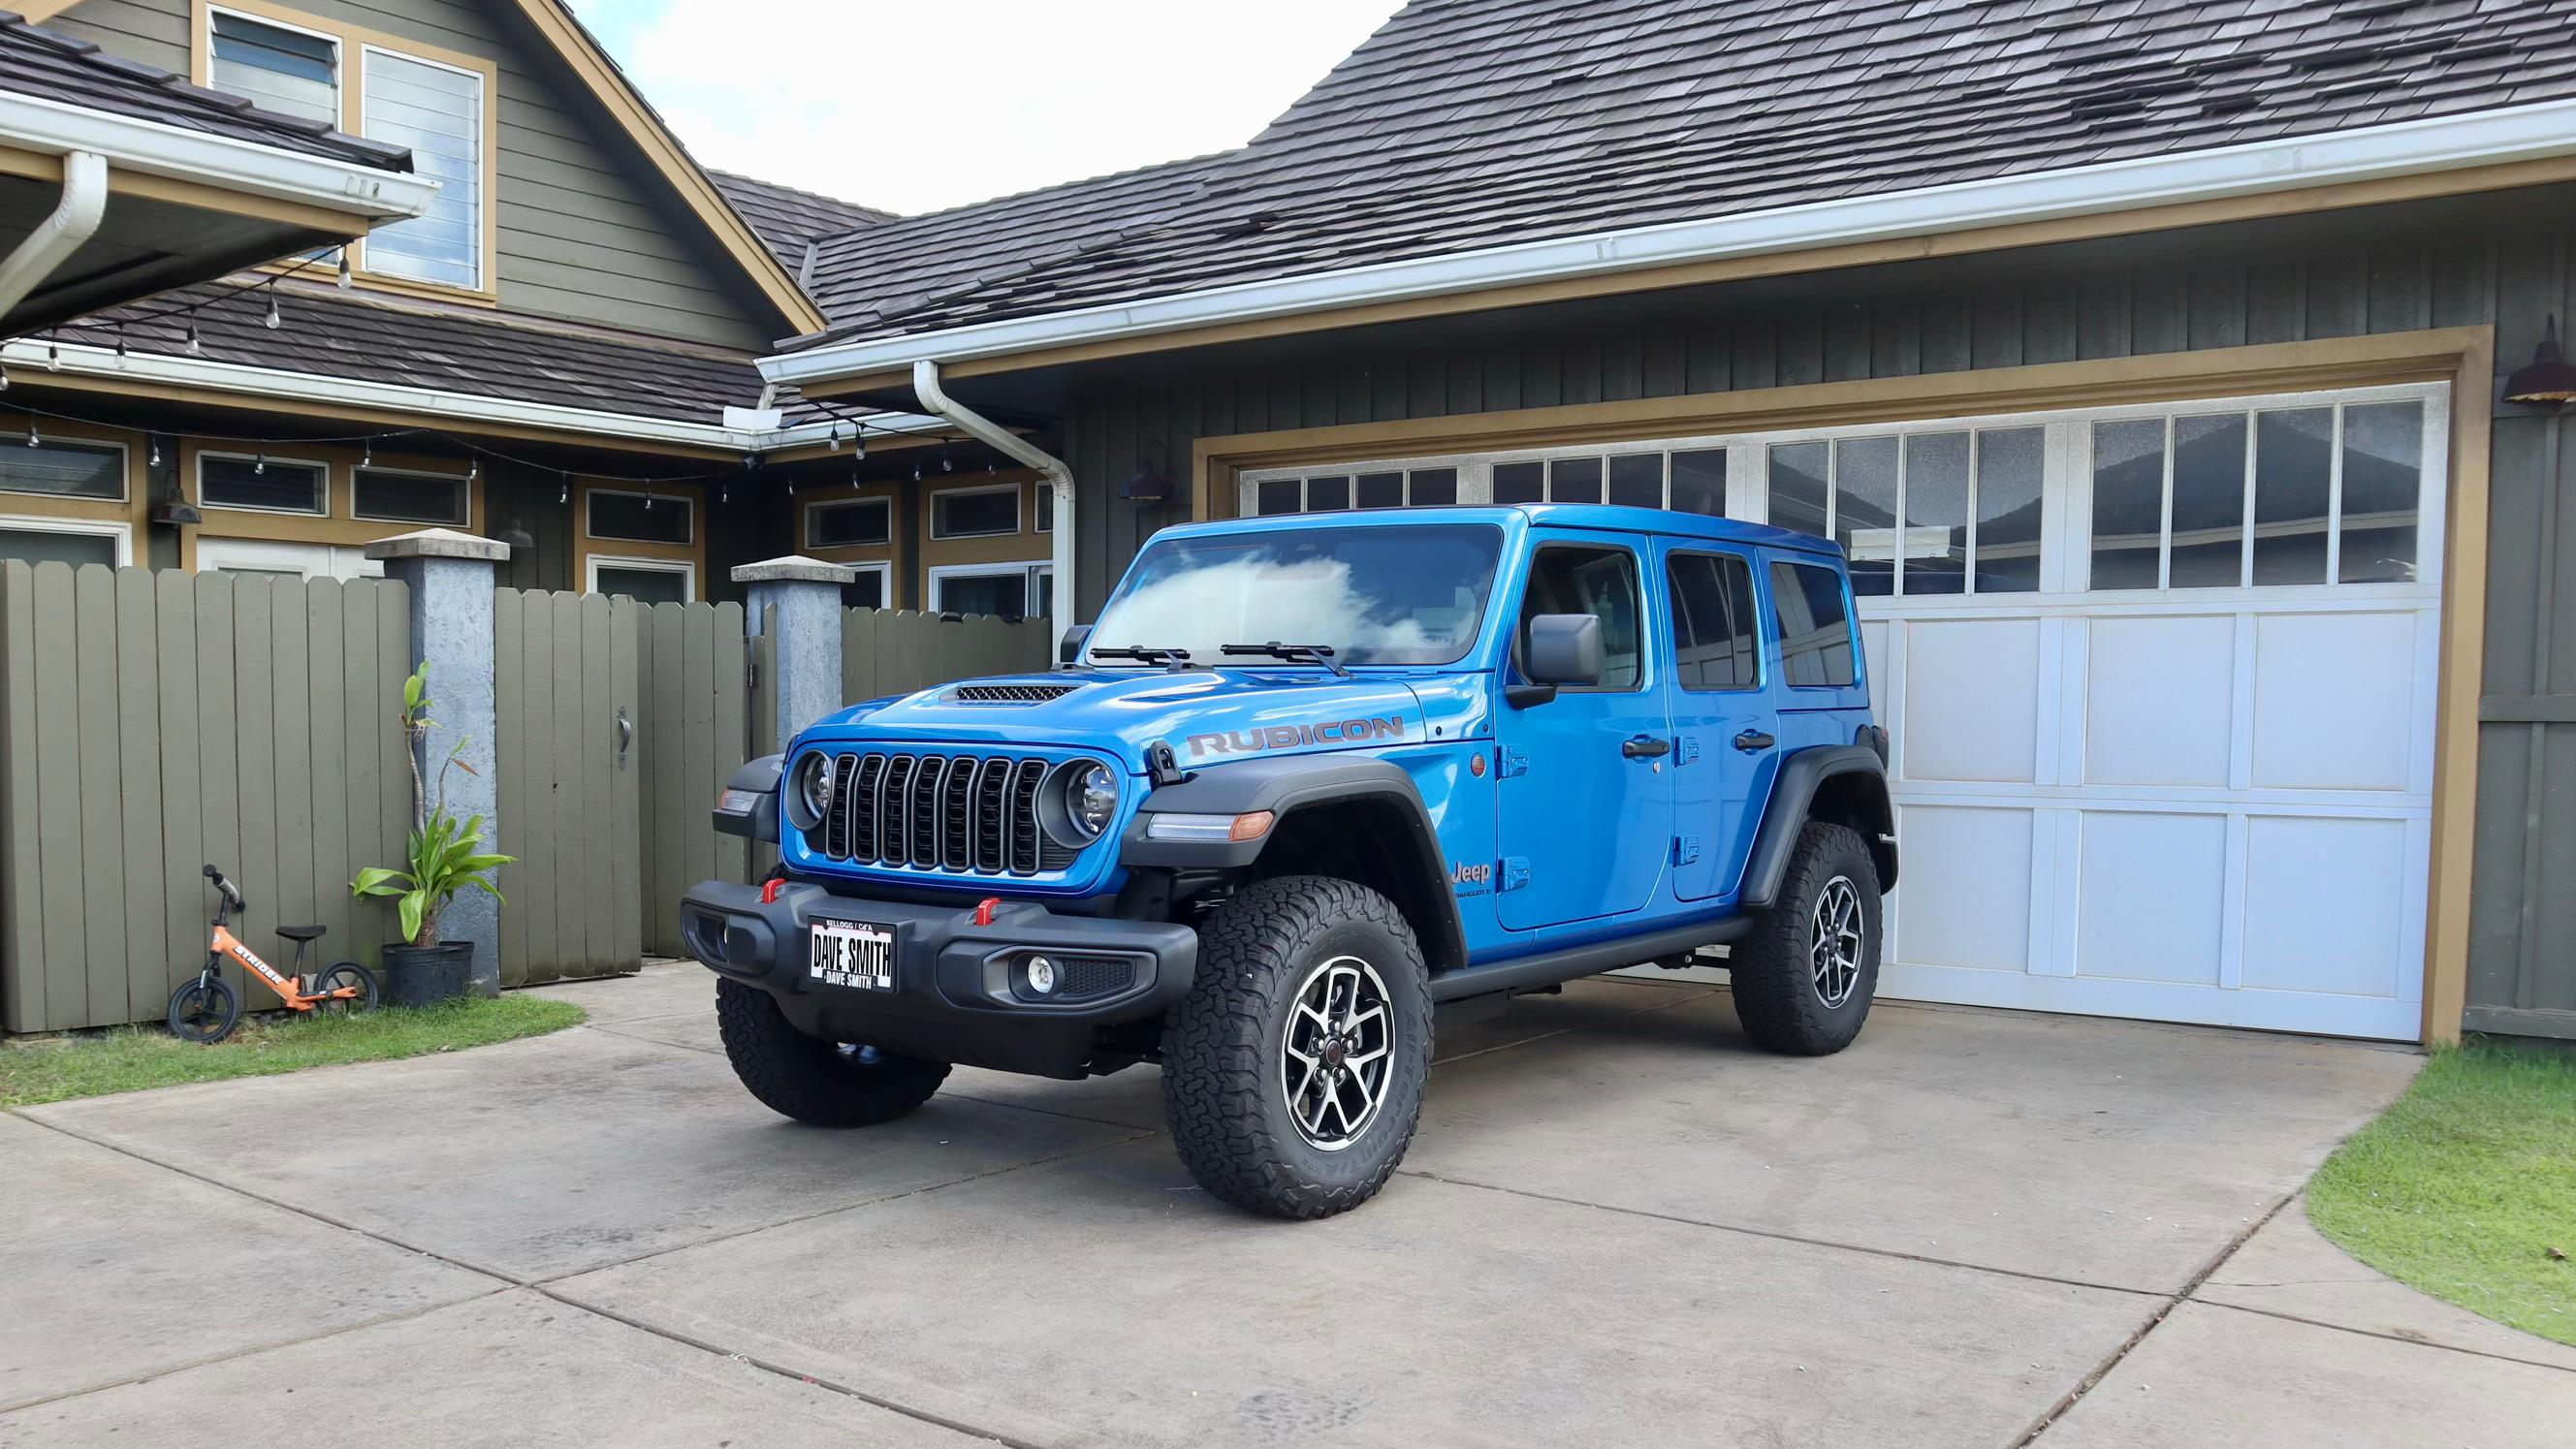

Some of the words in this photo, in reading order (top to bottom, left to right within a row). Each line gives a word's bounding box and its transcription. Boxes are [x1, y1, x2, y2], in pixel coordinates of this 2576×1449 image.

[1186, 715, 1405, 758] RUBICON
[1450, 861, 1491, 885] Jeep
[826, 920, 853, 929] KELLOGG
[233, 945, 285, 985] STRIDER
[813, 933, 843, 970] DAVE
[848, 937, 891, 977] SMITH
[826, 970, 845, 986] DAVE
[846, 973, 873, 990] SMITH
